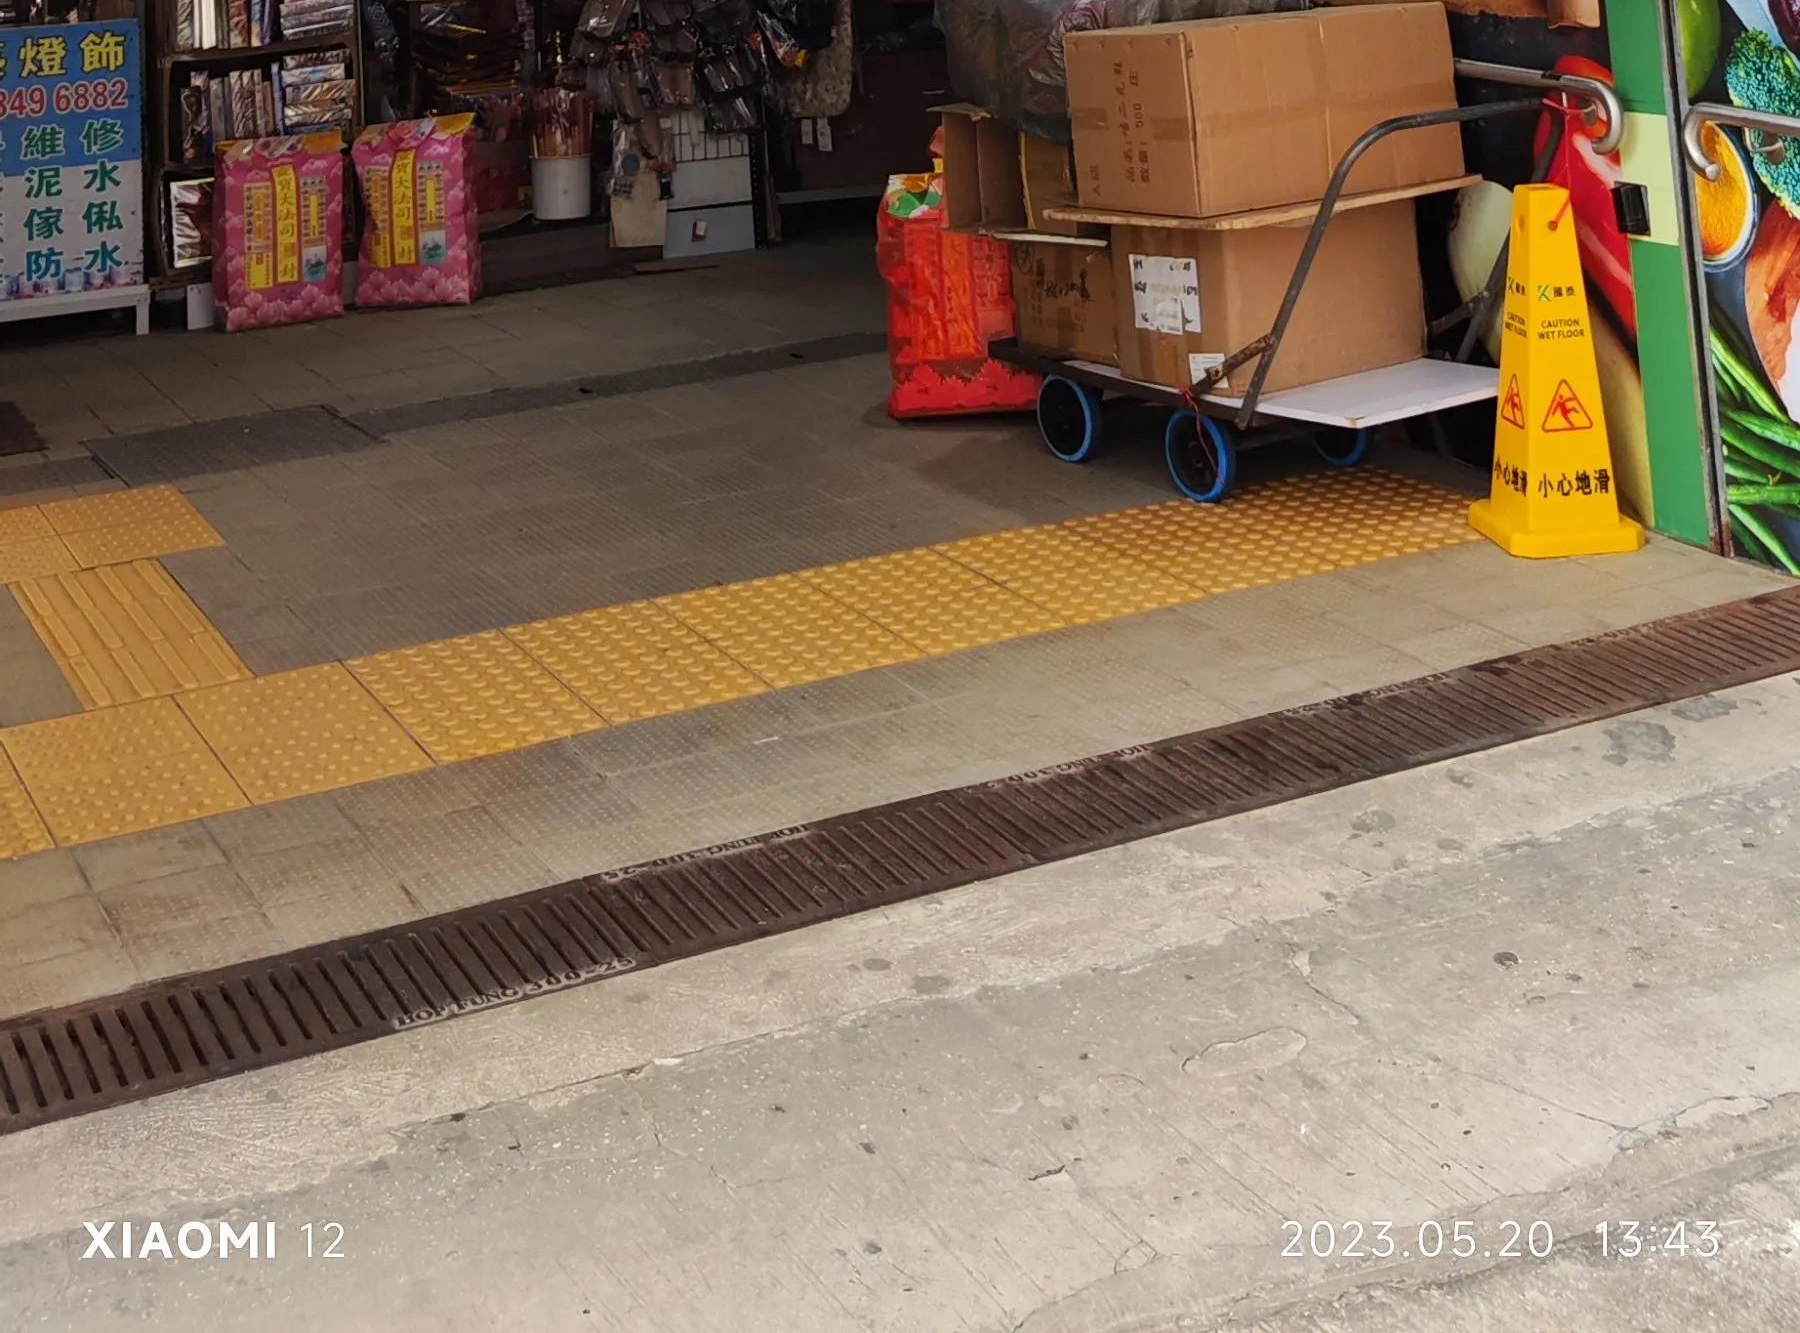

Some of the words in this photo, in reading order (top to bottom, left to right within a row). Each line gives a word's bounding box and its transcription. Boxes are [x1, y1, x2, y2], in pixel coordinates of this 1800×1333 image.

[0, 33, 126, 79] 燈飾
[54, 77, 129, 114] 6882
[0, 117, 124, 165] 維修
[0, 159, 122, 200] 泥水
[0, 200, 124, 243] 傢俬
[0, 240, 124, 283] 防水
[1537, 331, 1556, 340] WET
[1557, 329, 1584, 339] FLOOR
[1541, 318, 1580, 329] CAUTION
[1494, 455, 1528, 497] 小心地滑
[1538, 468, 1611, 498] 小心地滑
[455, 986, 521, 1013] FUNG
